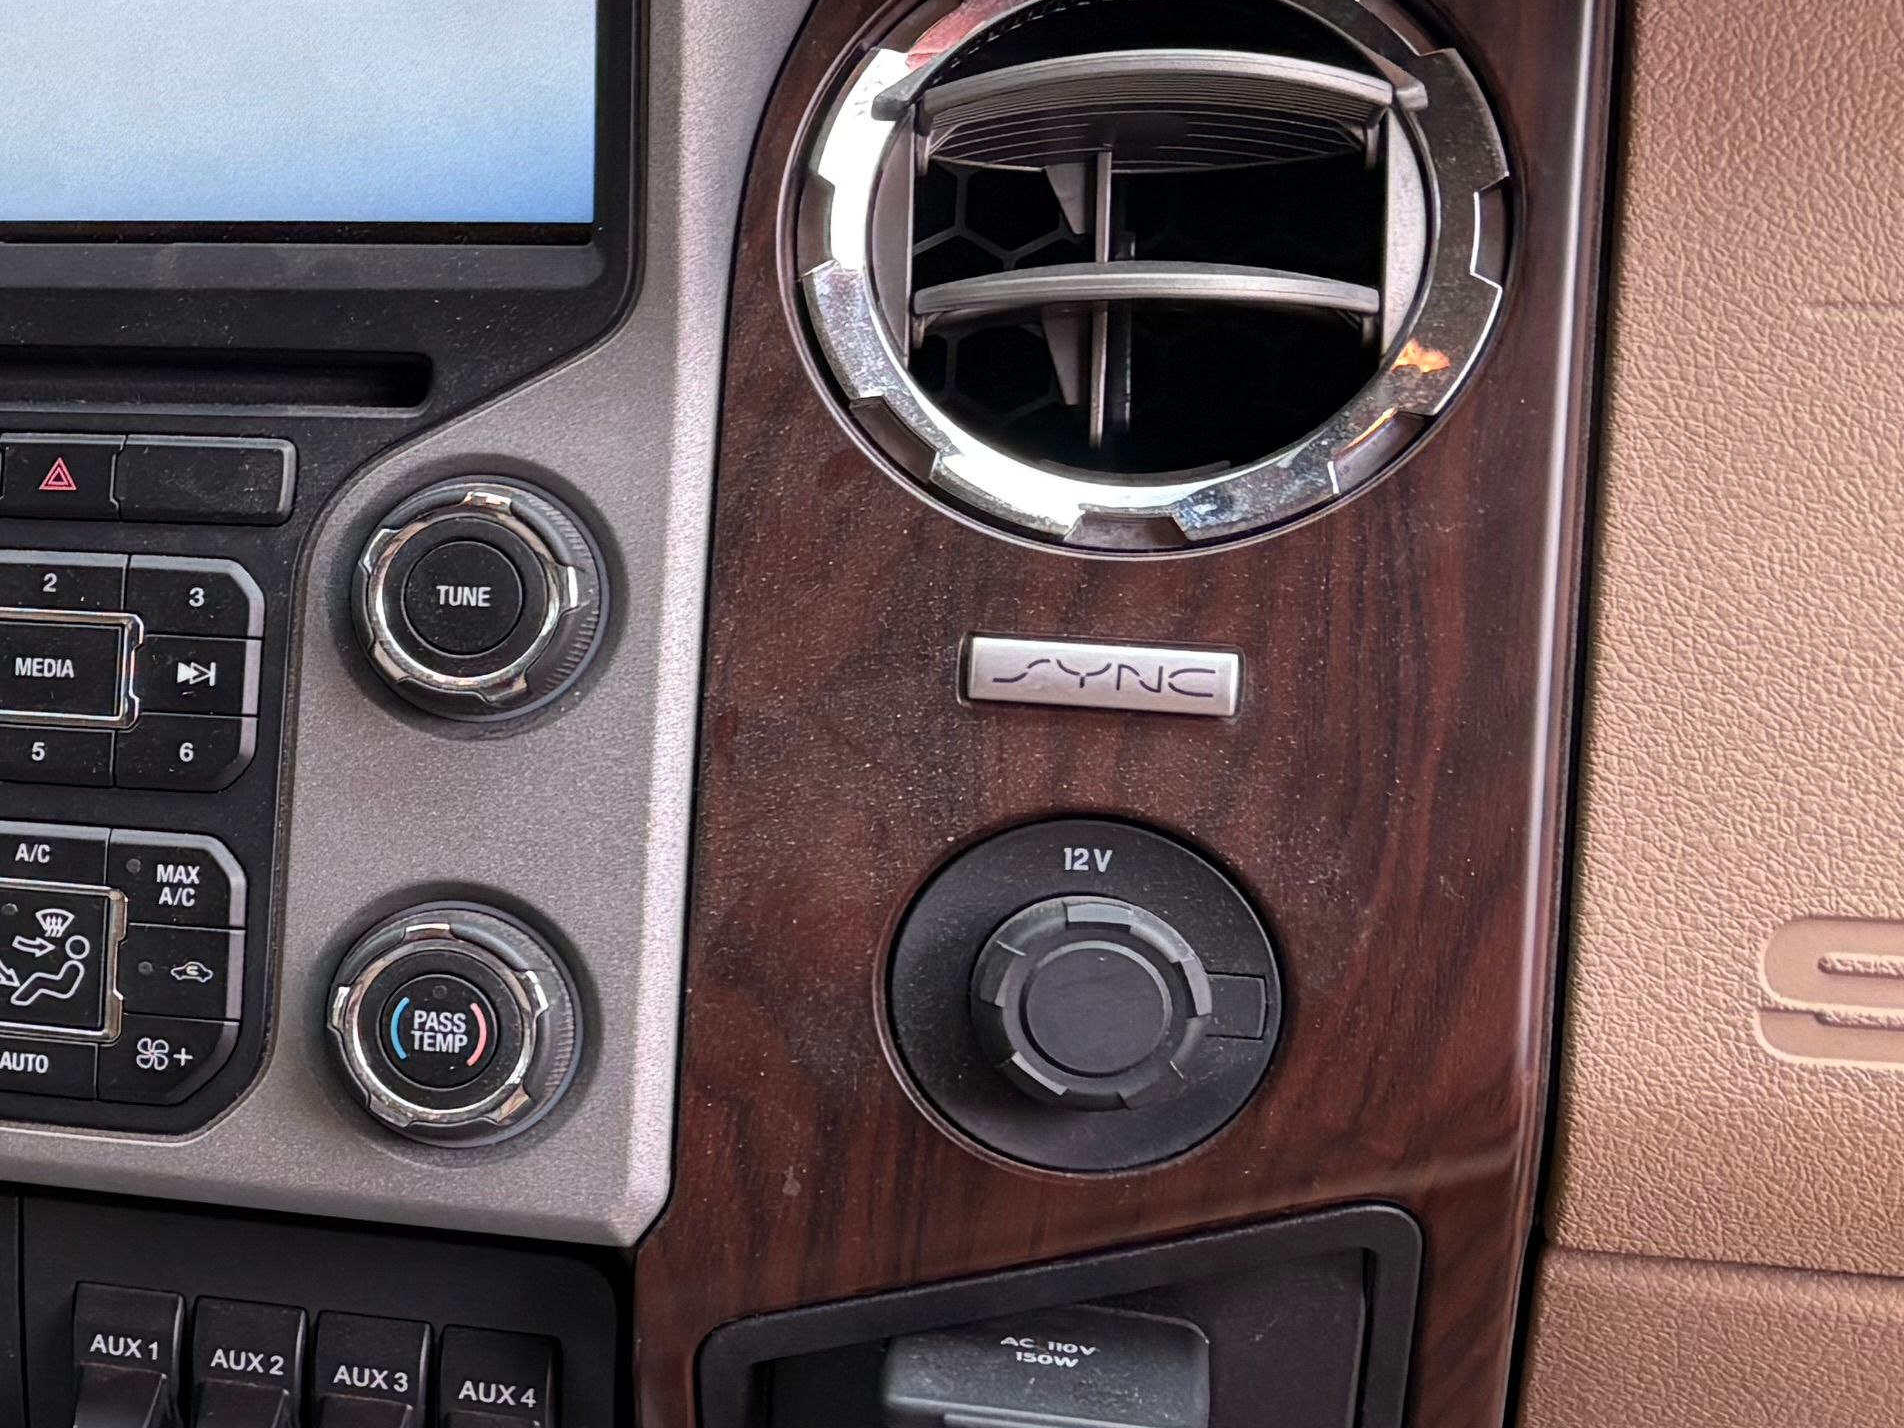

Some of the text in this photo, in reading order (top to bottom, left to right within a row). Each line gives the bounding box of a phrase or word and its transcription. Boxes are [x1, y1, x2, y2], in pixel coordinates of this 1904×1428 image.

[43, 573, 57, 592] 2
[189, 587, 204, 607] 3
[436, 586, 491, 606] TUNE
[15, 658, 74, 678] MEDIA
[992, 658, 1216, 698] SYNC
[32, 742, 45, 760] 5
[180, 743, 193, 762] 6
[15, 843, 50, 863] A/C
[1064, 848, 1112, 872] 12V
[157, 865, 199, 884] MAX
[159, 887, 195, 906] A/C
[413, 1010, 466, 1032] PASS
[411, 1030, 467, 1053] TEMP
[0, 1051, 48, 1073] AUTO
[90, 1334, 157, 1360] AUX 1
[1000, 1337, 1096, 1355] AC 110V
[211, 1349, 283, 1375] AUX 2
[1016, 1352, 1078, 1367] 150W
[334, 1365, 408, 1392] AUX 3
[459, 1381, 536, 1407] AUX 4
